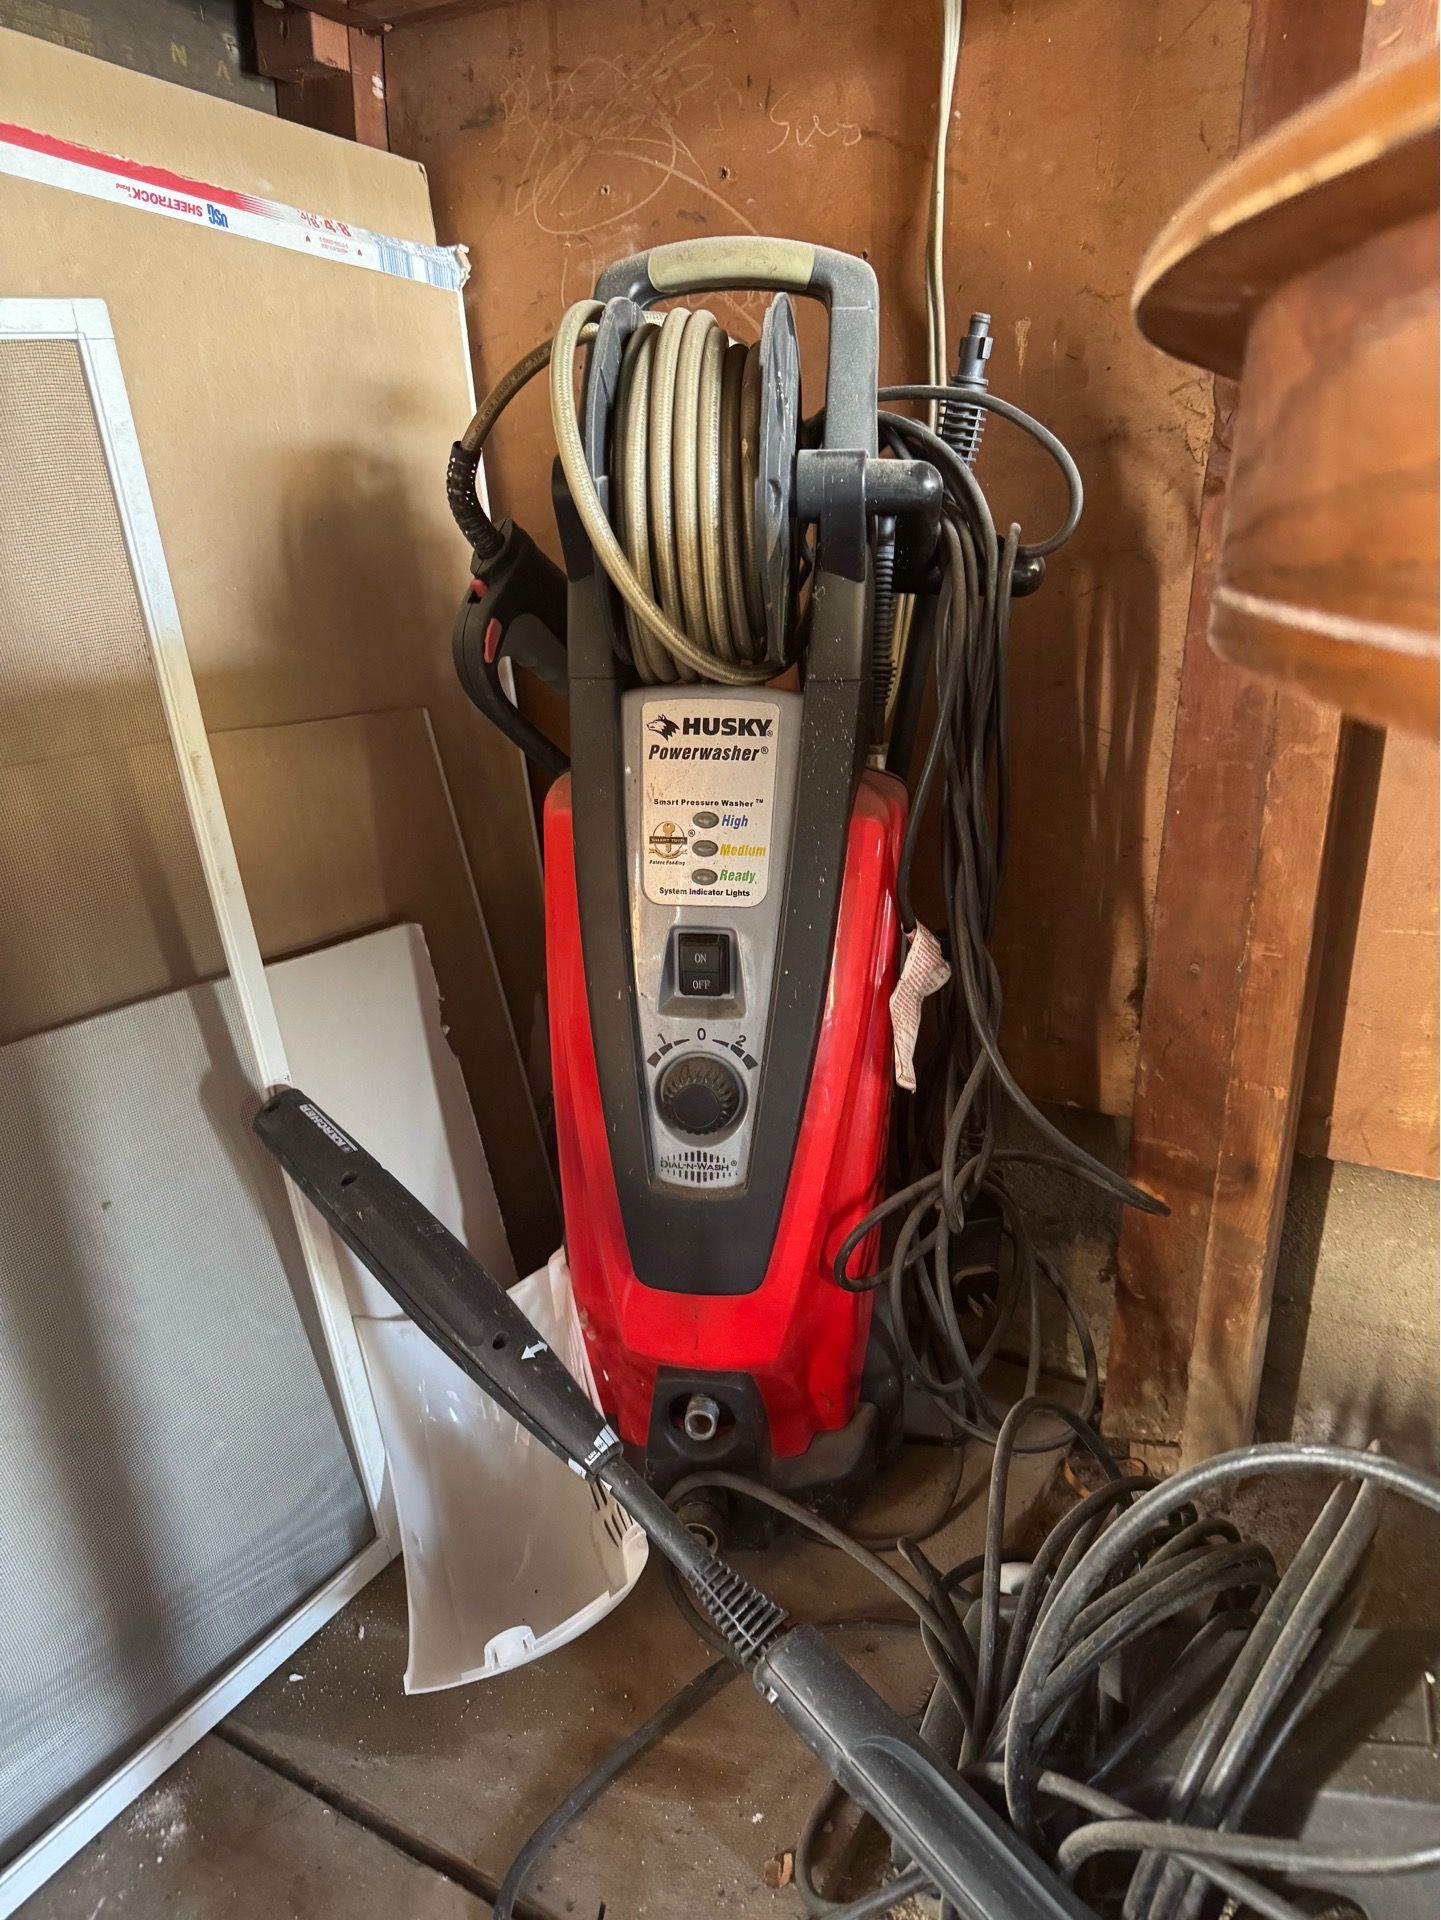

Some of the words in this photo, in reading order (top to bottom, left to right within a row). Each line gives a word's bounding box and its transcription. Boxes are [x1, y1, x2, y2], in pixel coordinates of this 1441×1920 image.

[132, 187, 203, 217] SHEETROCK
[206, 203, 229, 228] USG
[654, 798, 679, 806] Smart
[721, 799, 754, 807] Washer
[721, 814, 749, 829] High
[720, 844, 766, 857] Medium
[720, 869, 756, 883] Ready
[659, 887, 687, 896] System
[689, 888, 723, 897] Indicator
[725, 889, 750, 898] Lights
[694, 953, 707, 964] ON
[692, 979, 711, 990] OFF
[657, 1033, 667, 1044] 1
[697, 1027, 706, 1040] 0
[735, 1034, 747, 1048] 2
